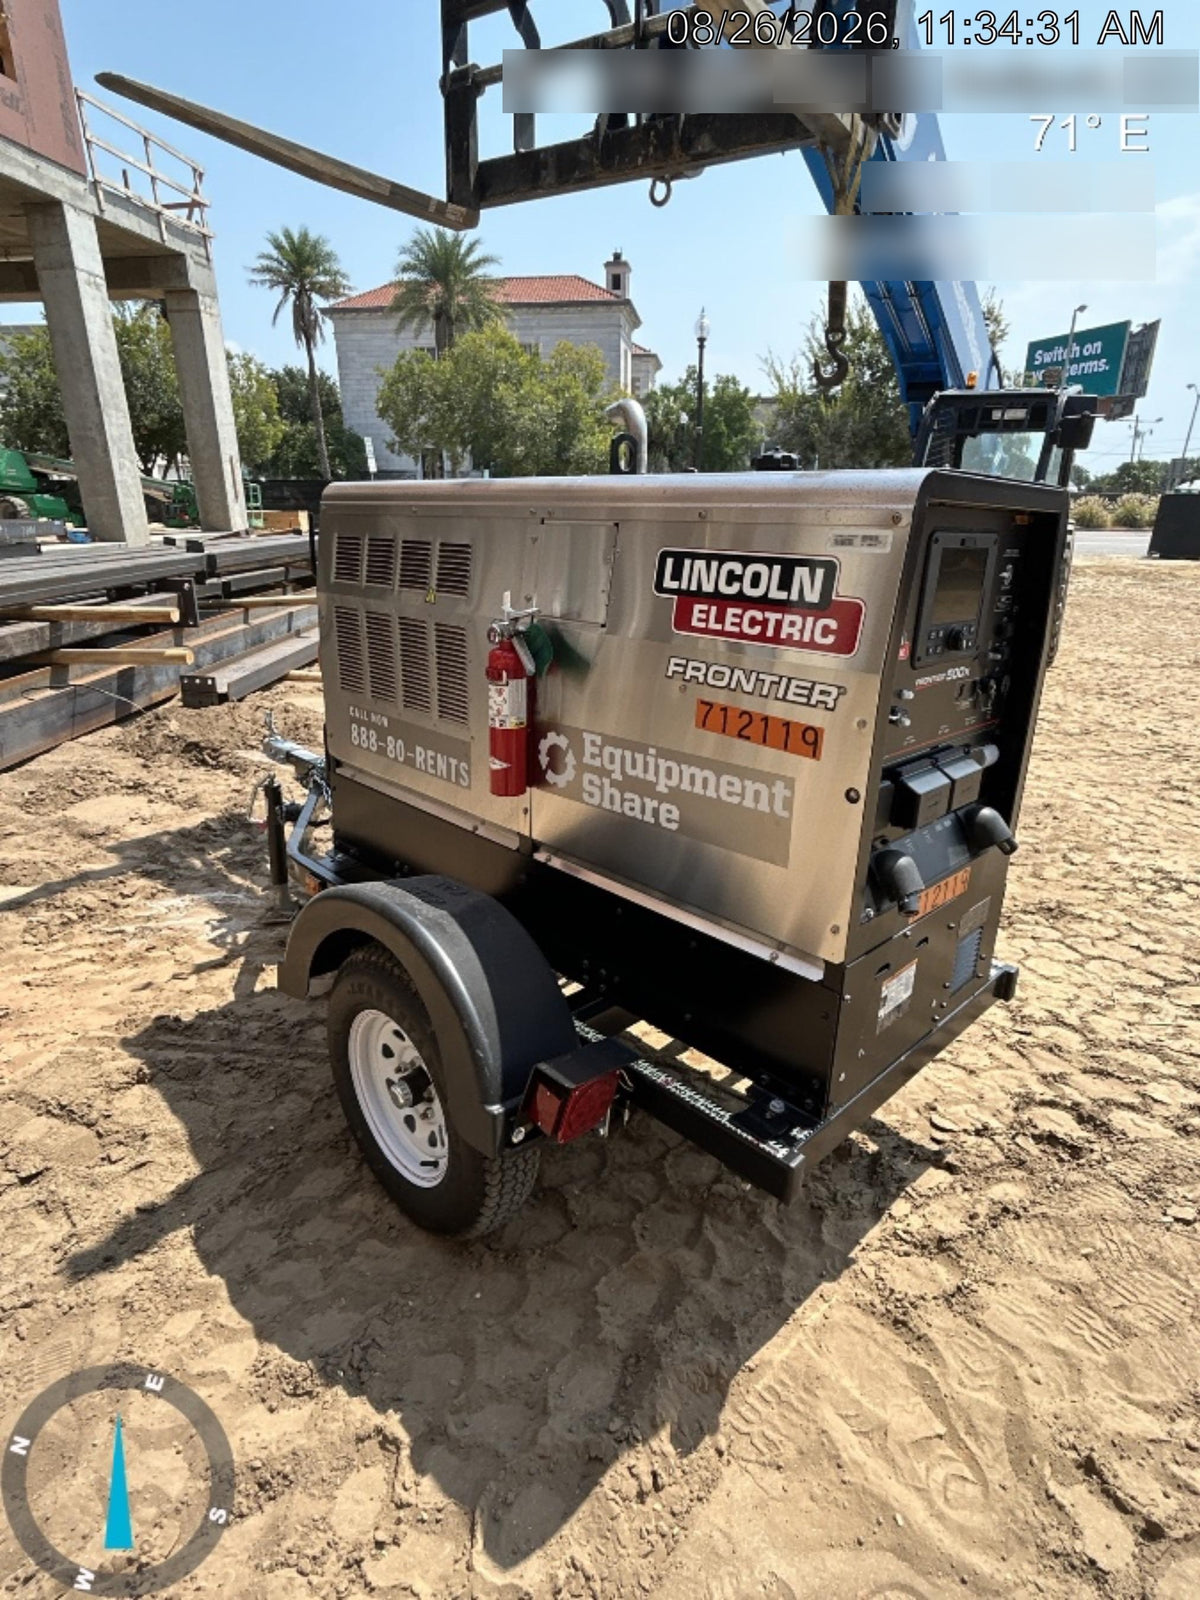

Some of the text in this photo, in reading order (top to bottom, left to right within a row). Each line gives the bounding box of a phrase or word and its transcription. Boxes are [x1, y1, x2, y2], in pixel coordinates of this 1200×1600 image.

[1082, 340, 1102, 356] on
[662, 557, 825, 604] LINCOLN
[691, 604, 838, 645] ELECTRIC
[351, 723, 470, 787] 888-80-RENTS
[700, 700, 820, 760] 712119
[582, 731, 792, 819] Equipment
[582, 772, 681, 831] Share
[918, 868, 969, 912] 12119
